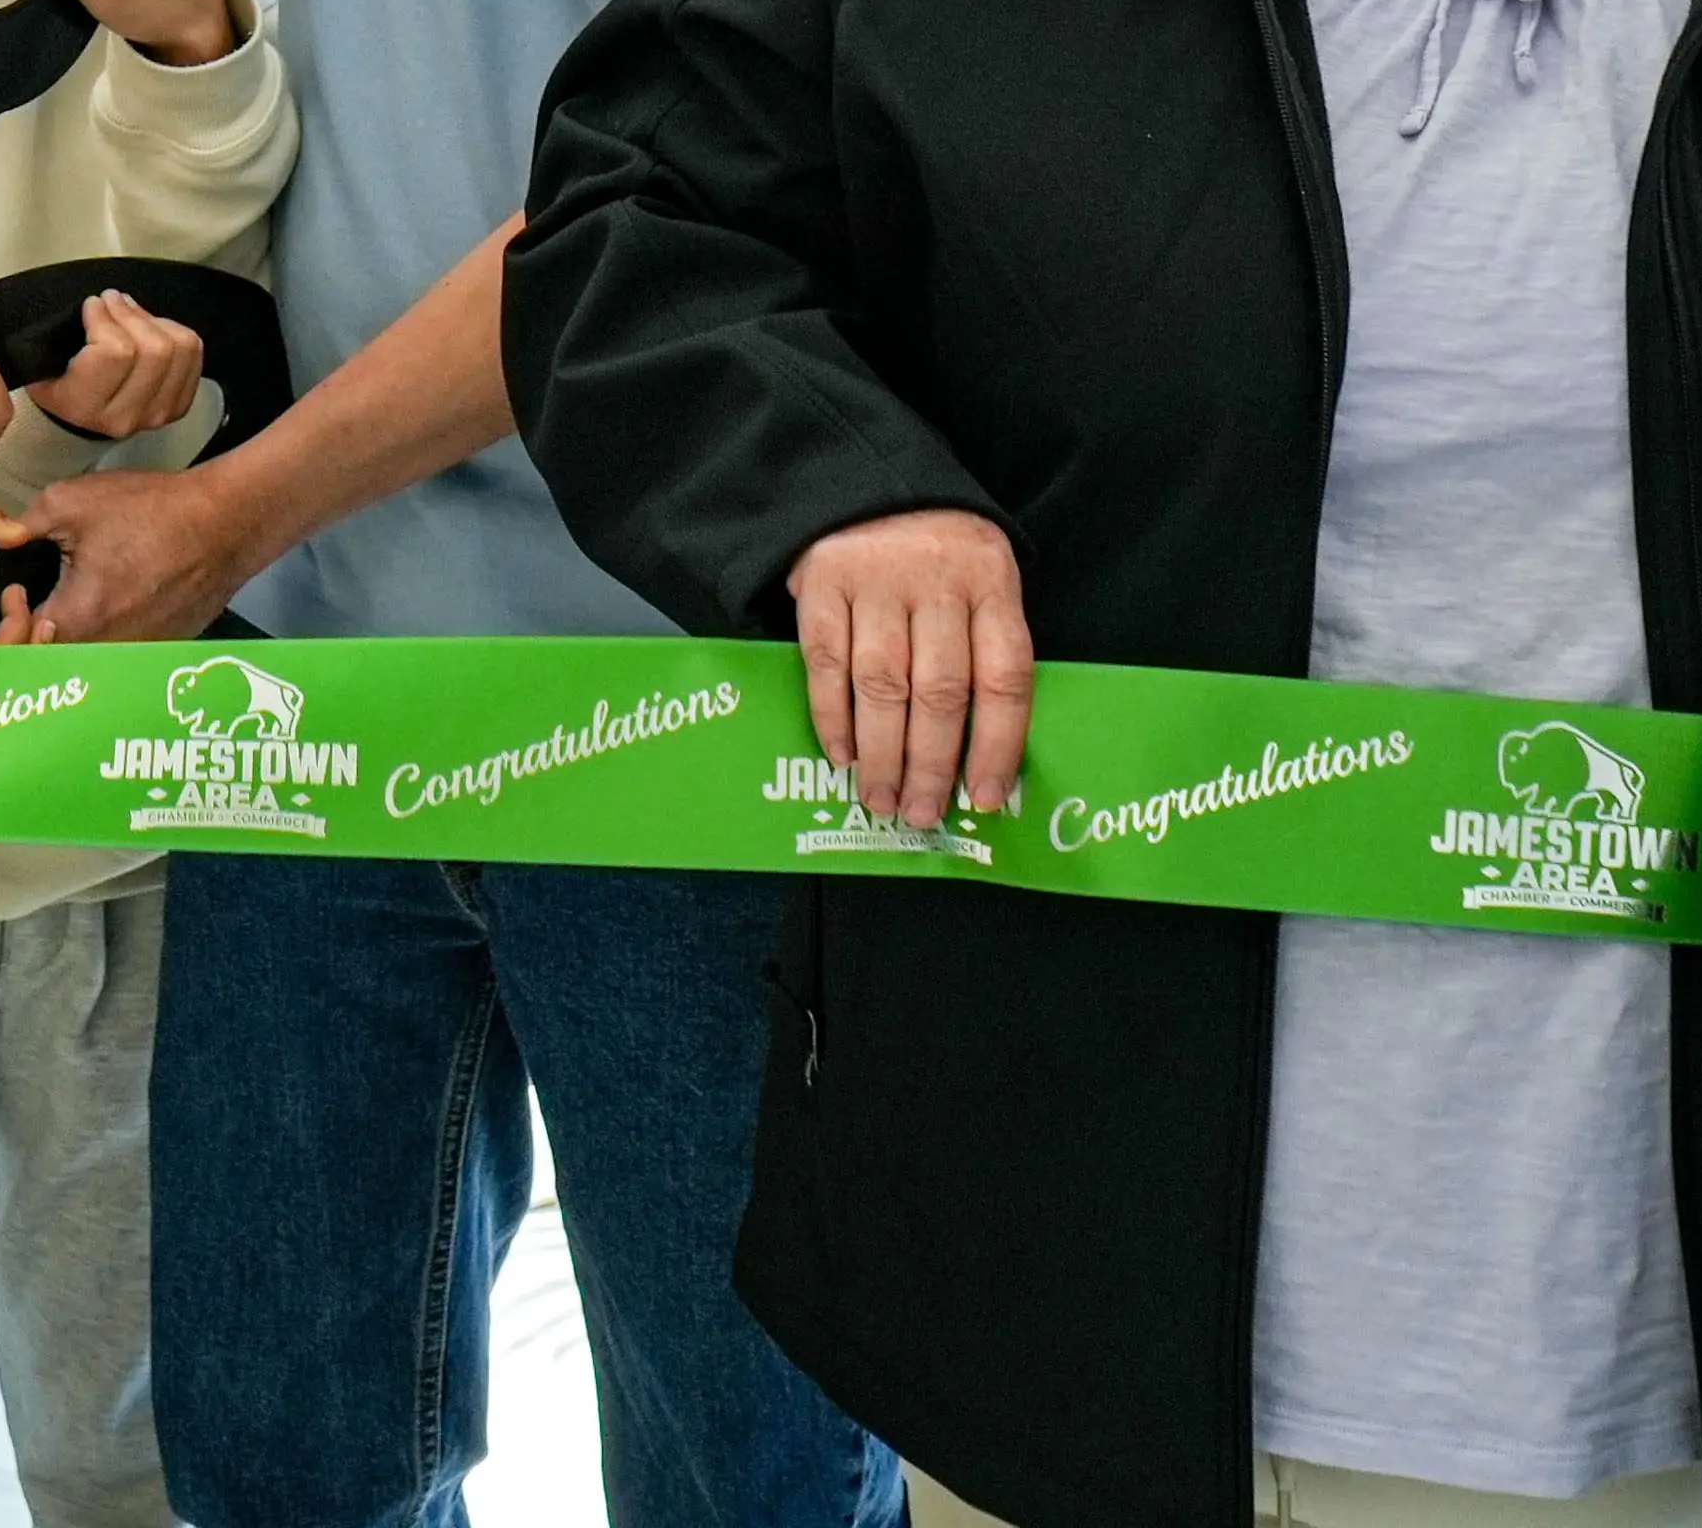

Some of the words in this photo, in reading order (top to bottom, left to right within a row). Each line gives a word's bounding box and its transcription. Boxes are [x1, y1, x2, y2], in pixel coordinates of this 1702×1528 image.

[99, 738, 359, 786] JAMESTOWN
[384, 680, 741, 819] Congratulations
[175, 781, 280, 811] AREA
[1049, 729, 1414, 854] Congratulations
[147, 811, 214, 823] CHAMBER
[232, 812, 308, 830] COMMERCE
[1430, 809, 1700, 873] JAMESTOWN
[1480, 890, 1551, 904] CHAMBER
[1510, 861, 1619, 897] AREA
